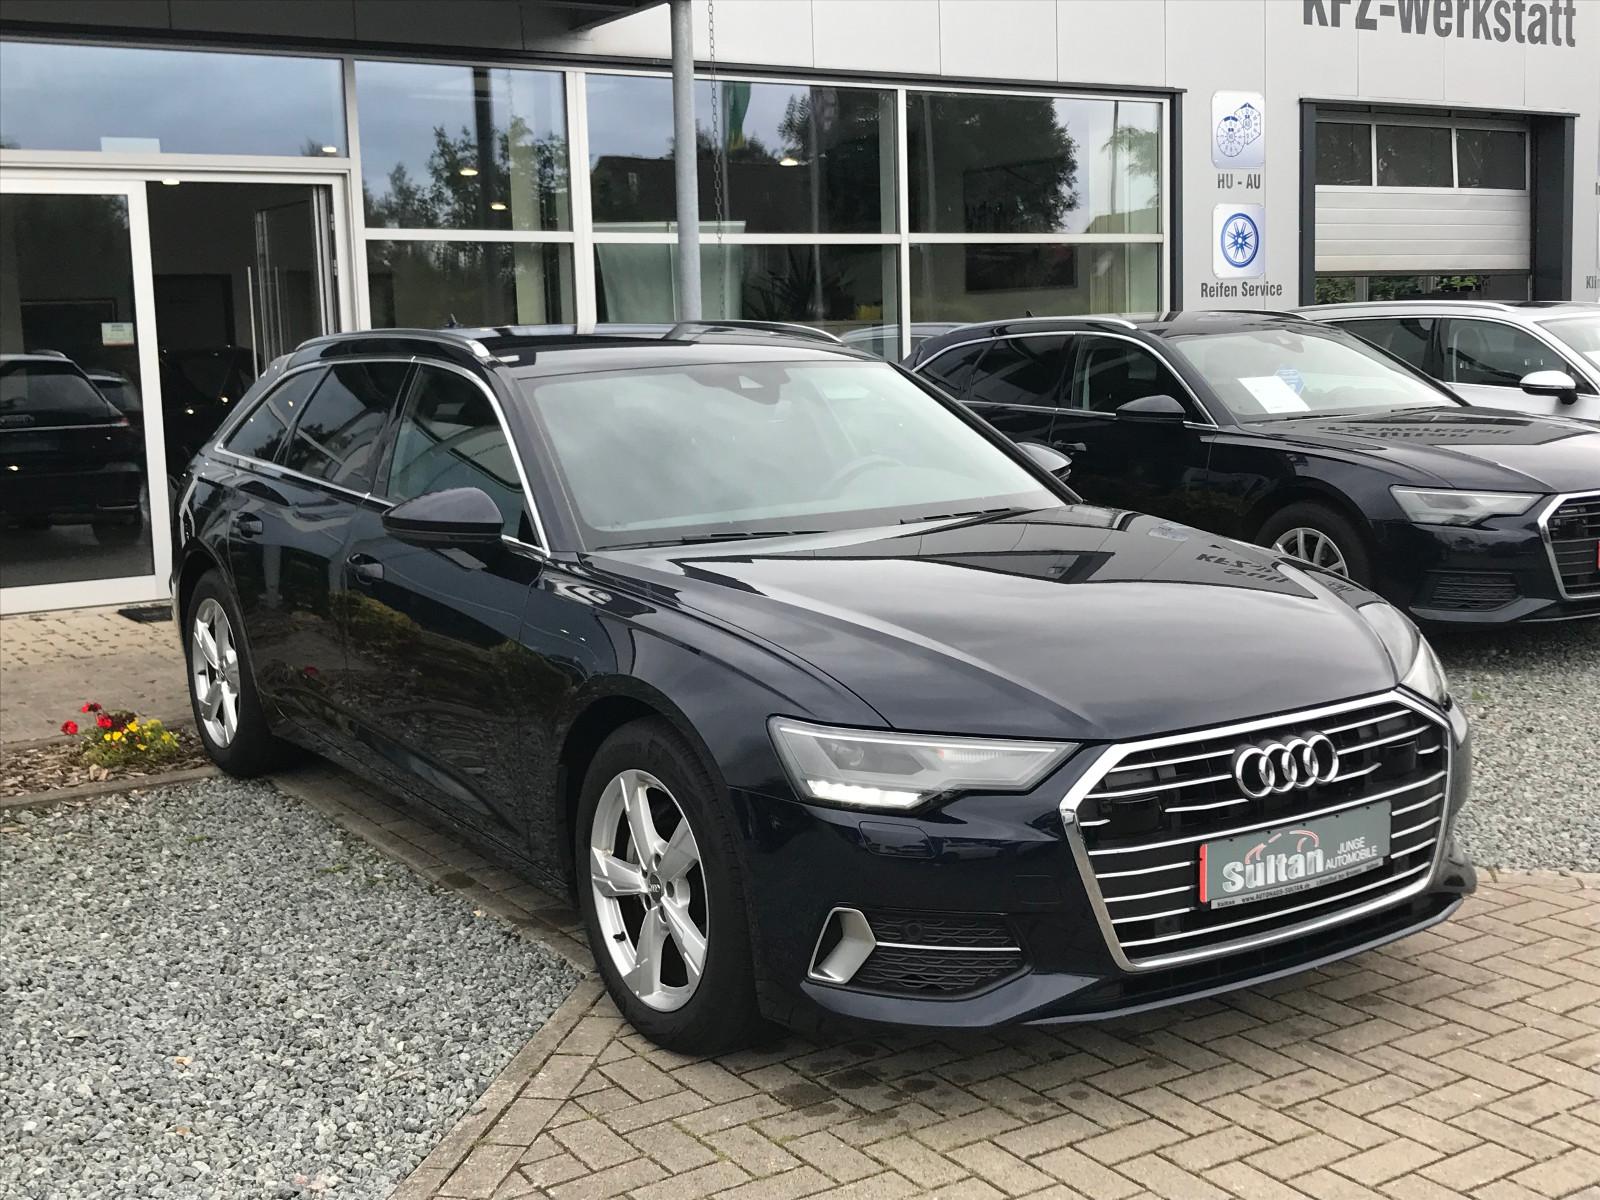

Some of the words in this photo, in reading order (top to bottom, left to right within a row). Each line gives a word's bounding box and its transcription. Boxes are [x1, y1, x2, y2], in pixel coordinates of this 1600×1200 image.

[1217, 173, 1234, 189] HU
[1246, 174, 1261, 189] AU
[1200, 282, 1238, 298] Reifen
[1241, 281, 1283, 297] Service
[1337, 836, 1366, 855] JUNGE
[1325, 845, 1378, 871] AUTOMOBILE
